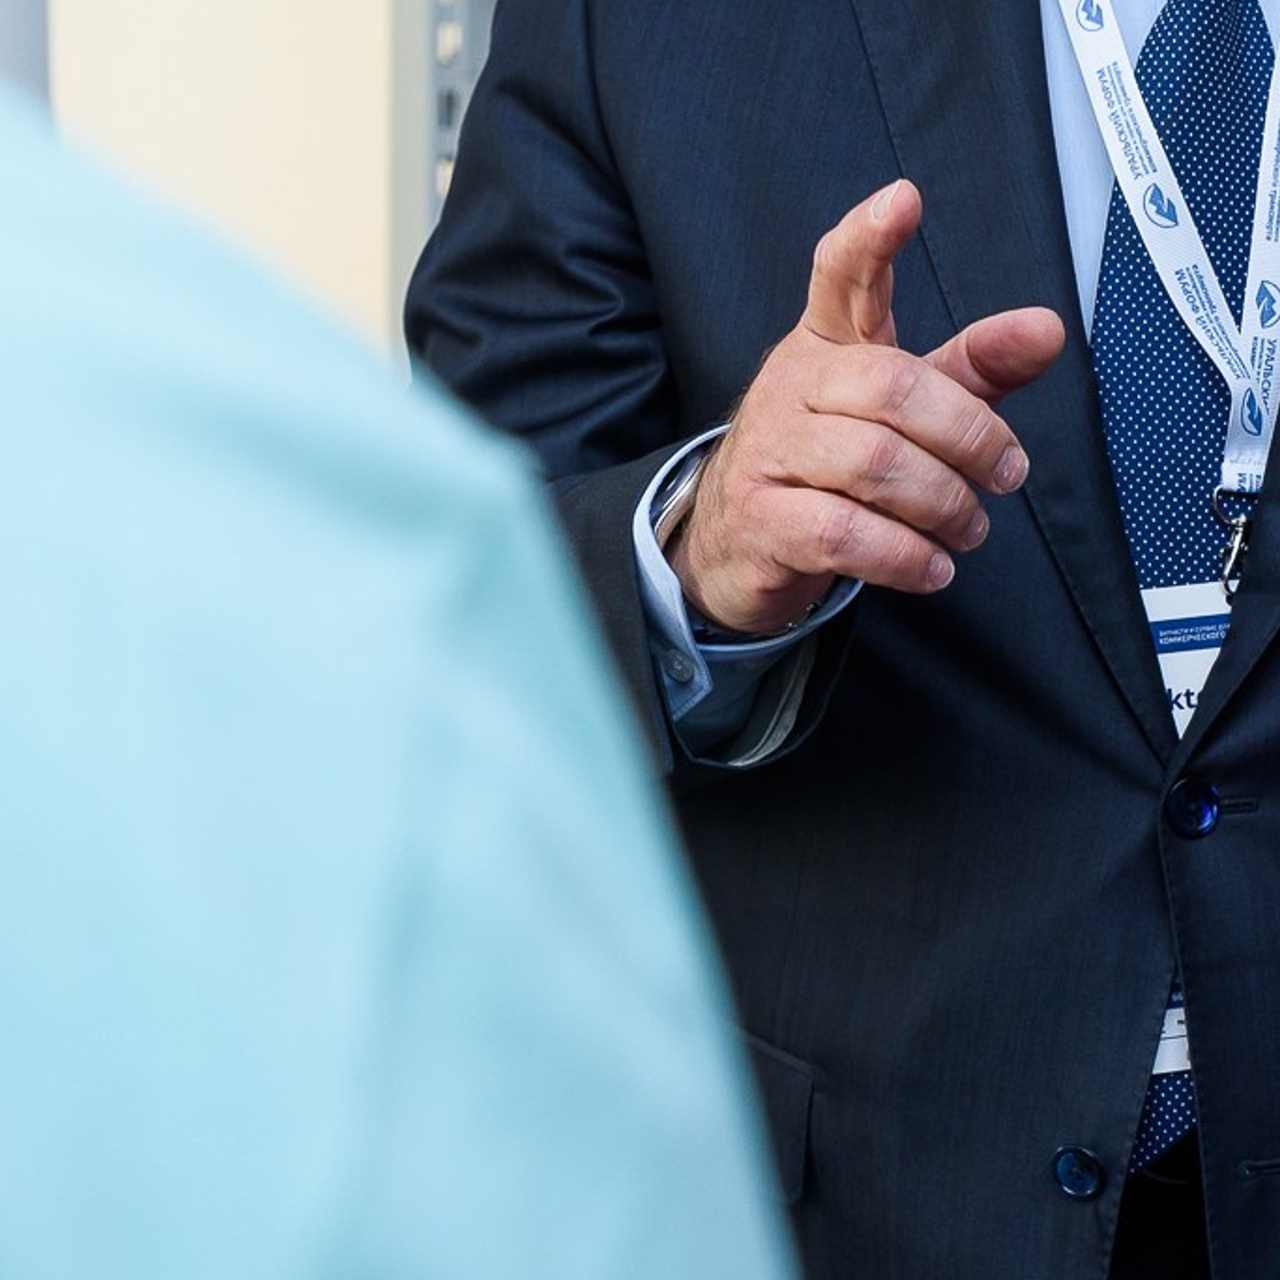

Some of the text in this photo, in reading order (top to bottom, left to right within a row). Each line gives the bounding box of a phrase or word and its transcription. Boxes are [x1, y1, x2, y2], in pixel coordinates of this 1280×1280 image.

[1097, 67, 1143, 180] УРАЛЬСКИЙ ФОРУМ
[1175, 269, 1199, 314] ФОРУМ
[1264, 340, 1277, 416] УРАЛЬСК
[1166, 688, 1198, 710] kt
